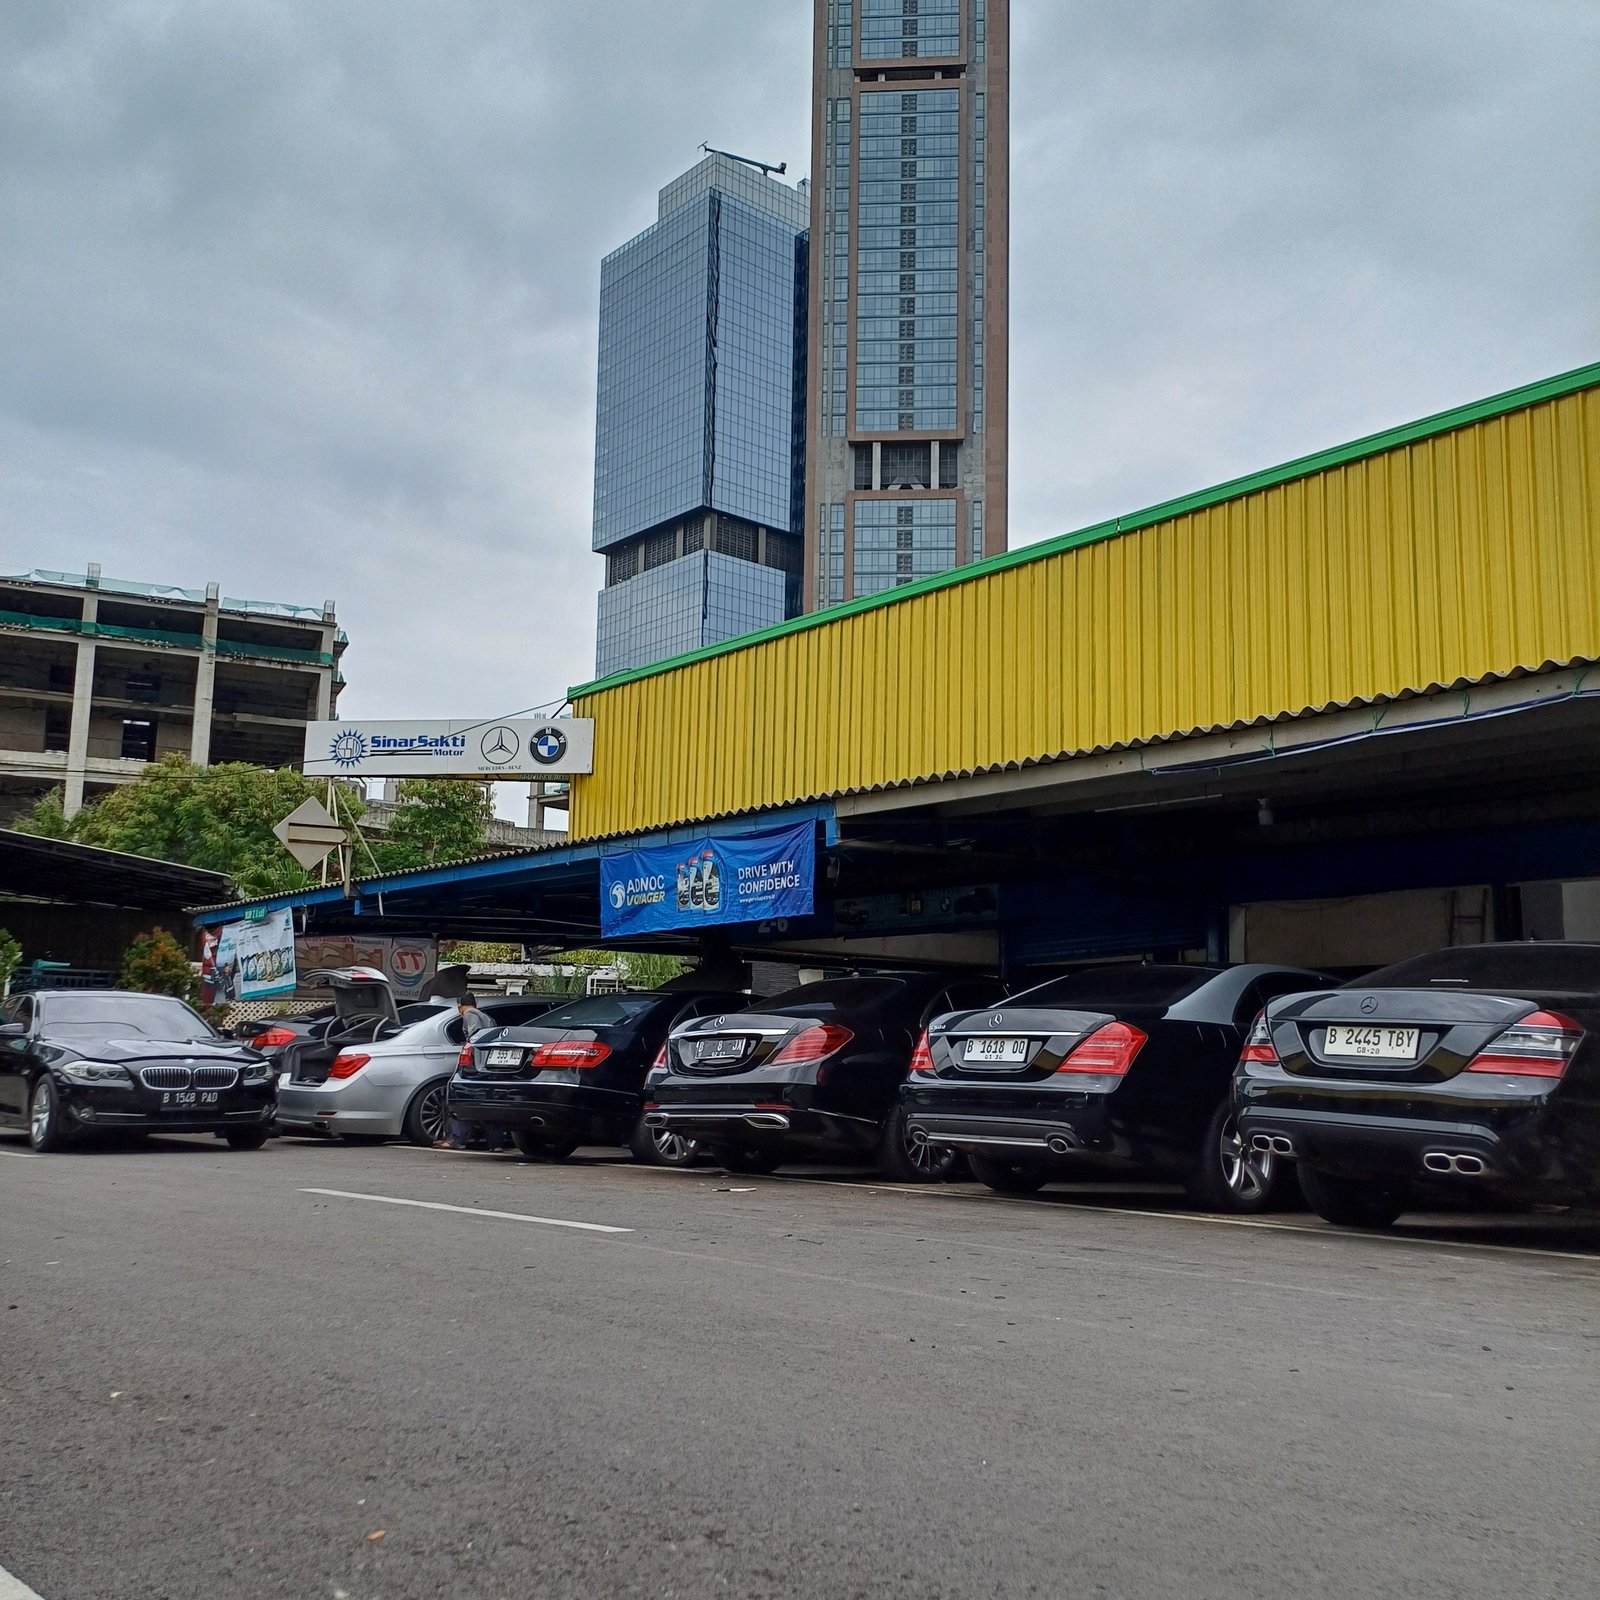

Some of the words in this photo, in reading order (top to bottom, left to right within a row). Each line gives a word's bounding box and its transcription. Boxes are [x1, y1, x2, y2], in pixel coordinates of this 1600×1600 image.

[531, 728, 566, 743] BMW
[738, 864, 767, 880] DRIVE
[769, 859, 794, 875] WITH
[626, 874, 665, 894] ADNOC
[738, 874, 800, 895] CONFIDENCE
[626, 890, 666, 906] VOYAGER
[1328, 1028, 1338, 1044] B
[1345, 1028, 1381, 1046] 2445
[1388, 1030, 1415, 1047] TBY
[698, 1041, 705, 1052] B
[717, 1040, 724, 1051] 8
[967, 1040, 974, 1053] B
[980, 1040, 1004, 1053] 1618
[163, 1093, 170, 1103] B
[201, 1092, 218, 1103] PAD
